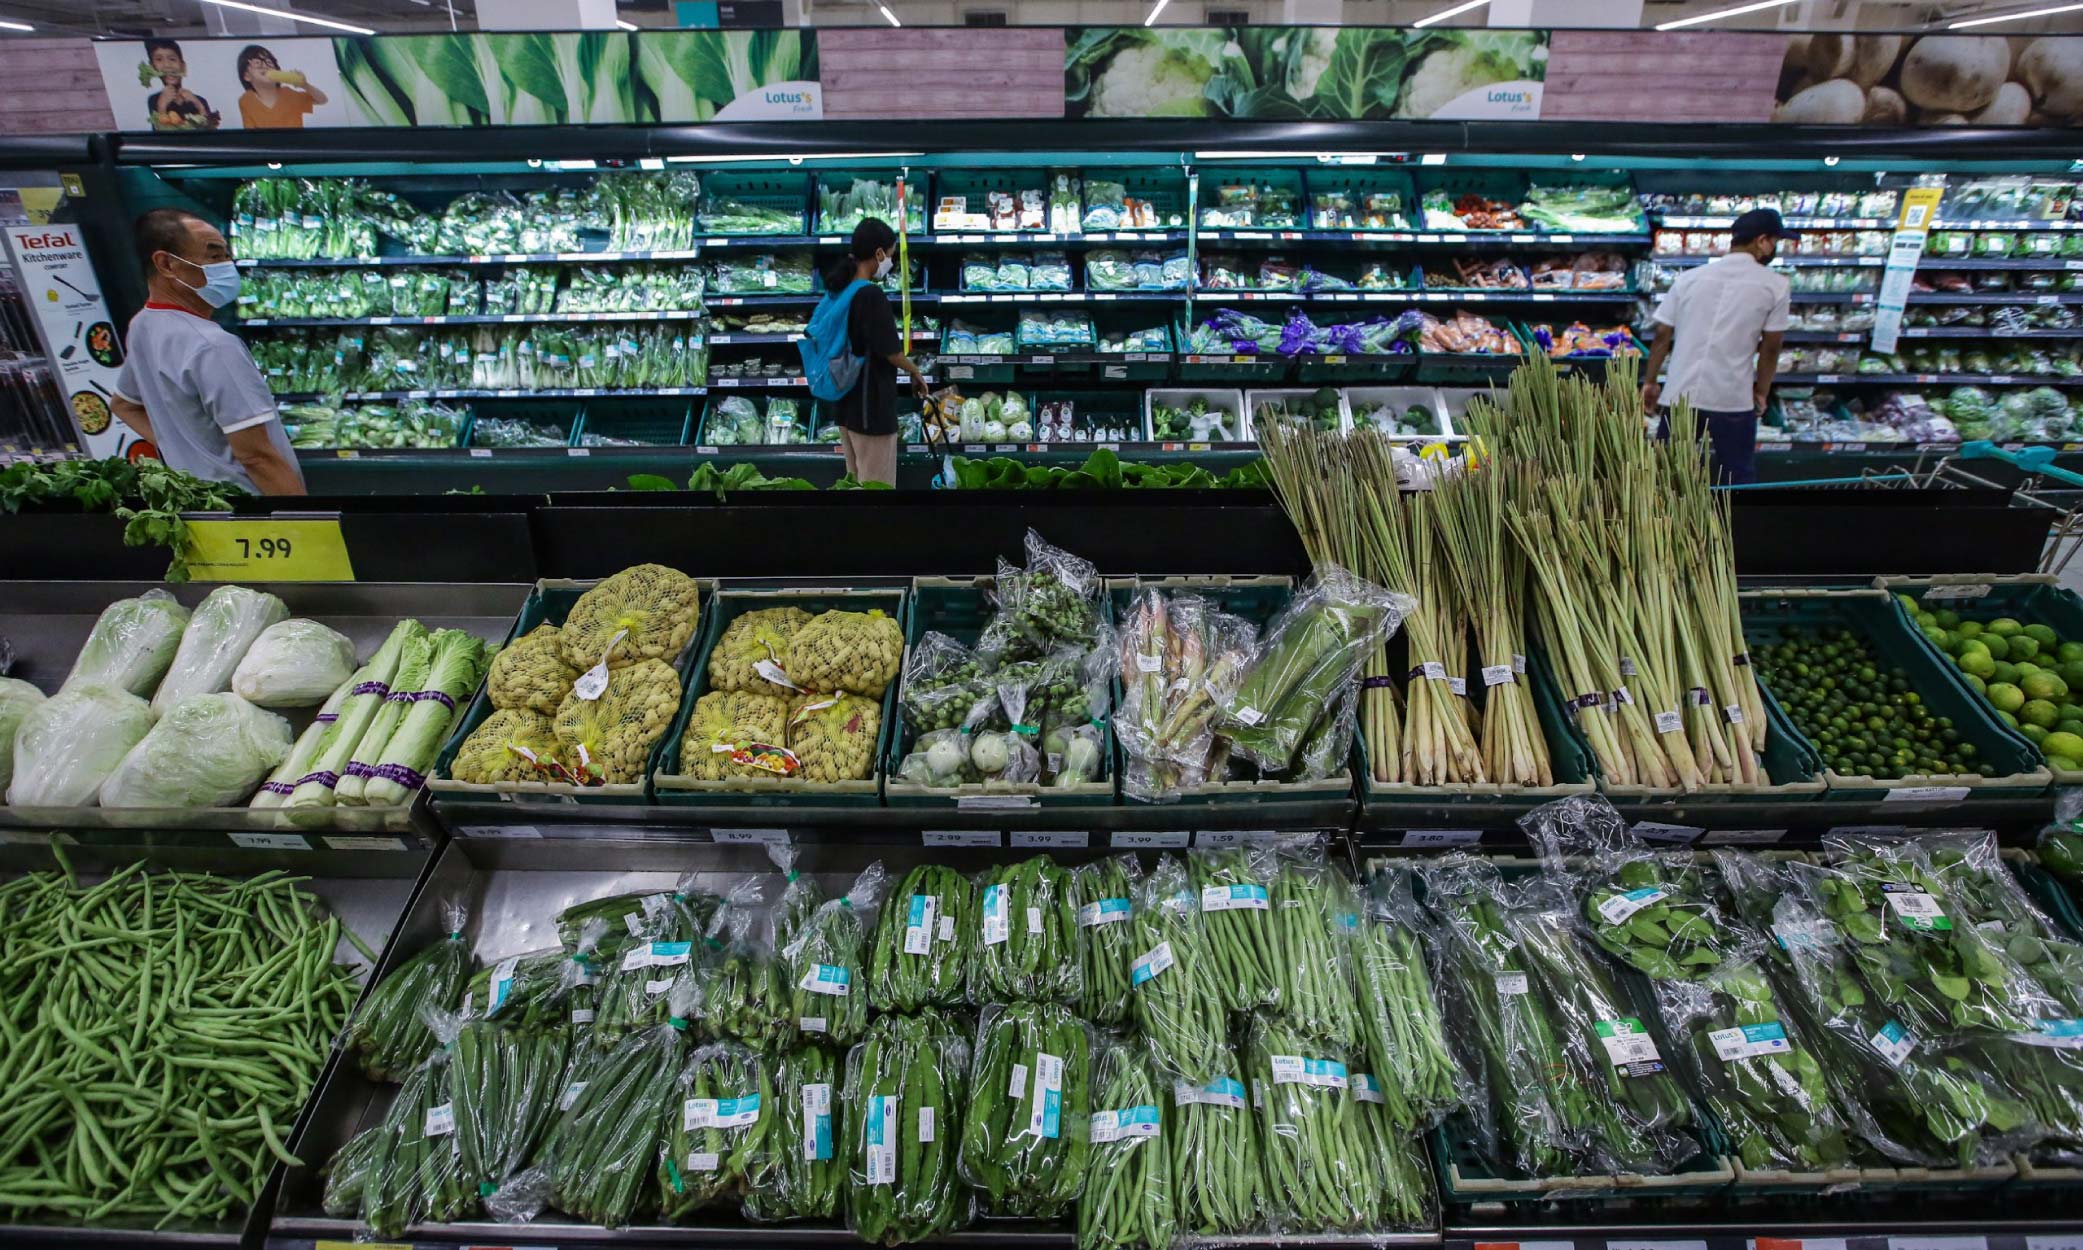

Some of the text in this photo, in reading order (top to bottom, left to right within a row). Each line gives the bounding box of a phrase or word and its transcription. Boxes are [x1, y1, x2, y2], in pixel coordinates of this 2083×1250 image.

[765, 92, 812, 104] Lotus's
[1488, 91, 1532, 103] Lotus's
[15, 232, 77, 249] Tefal
[22, 251, 83, 264] Kitchenware
[235, 538, 291, 559] 7.99
